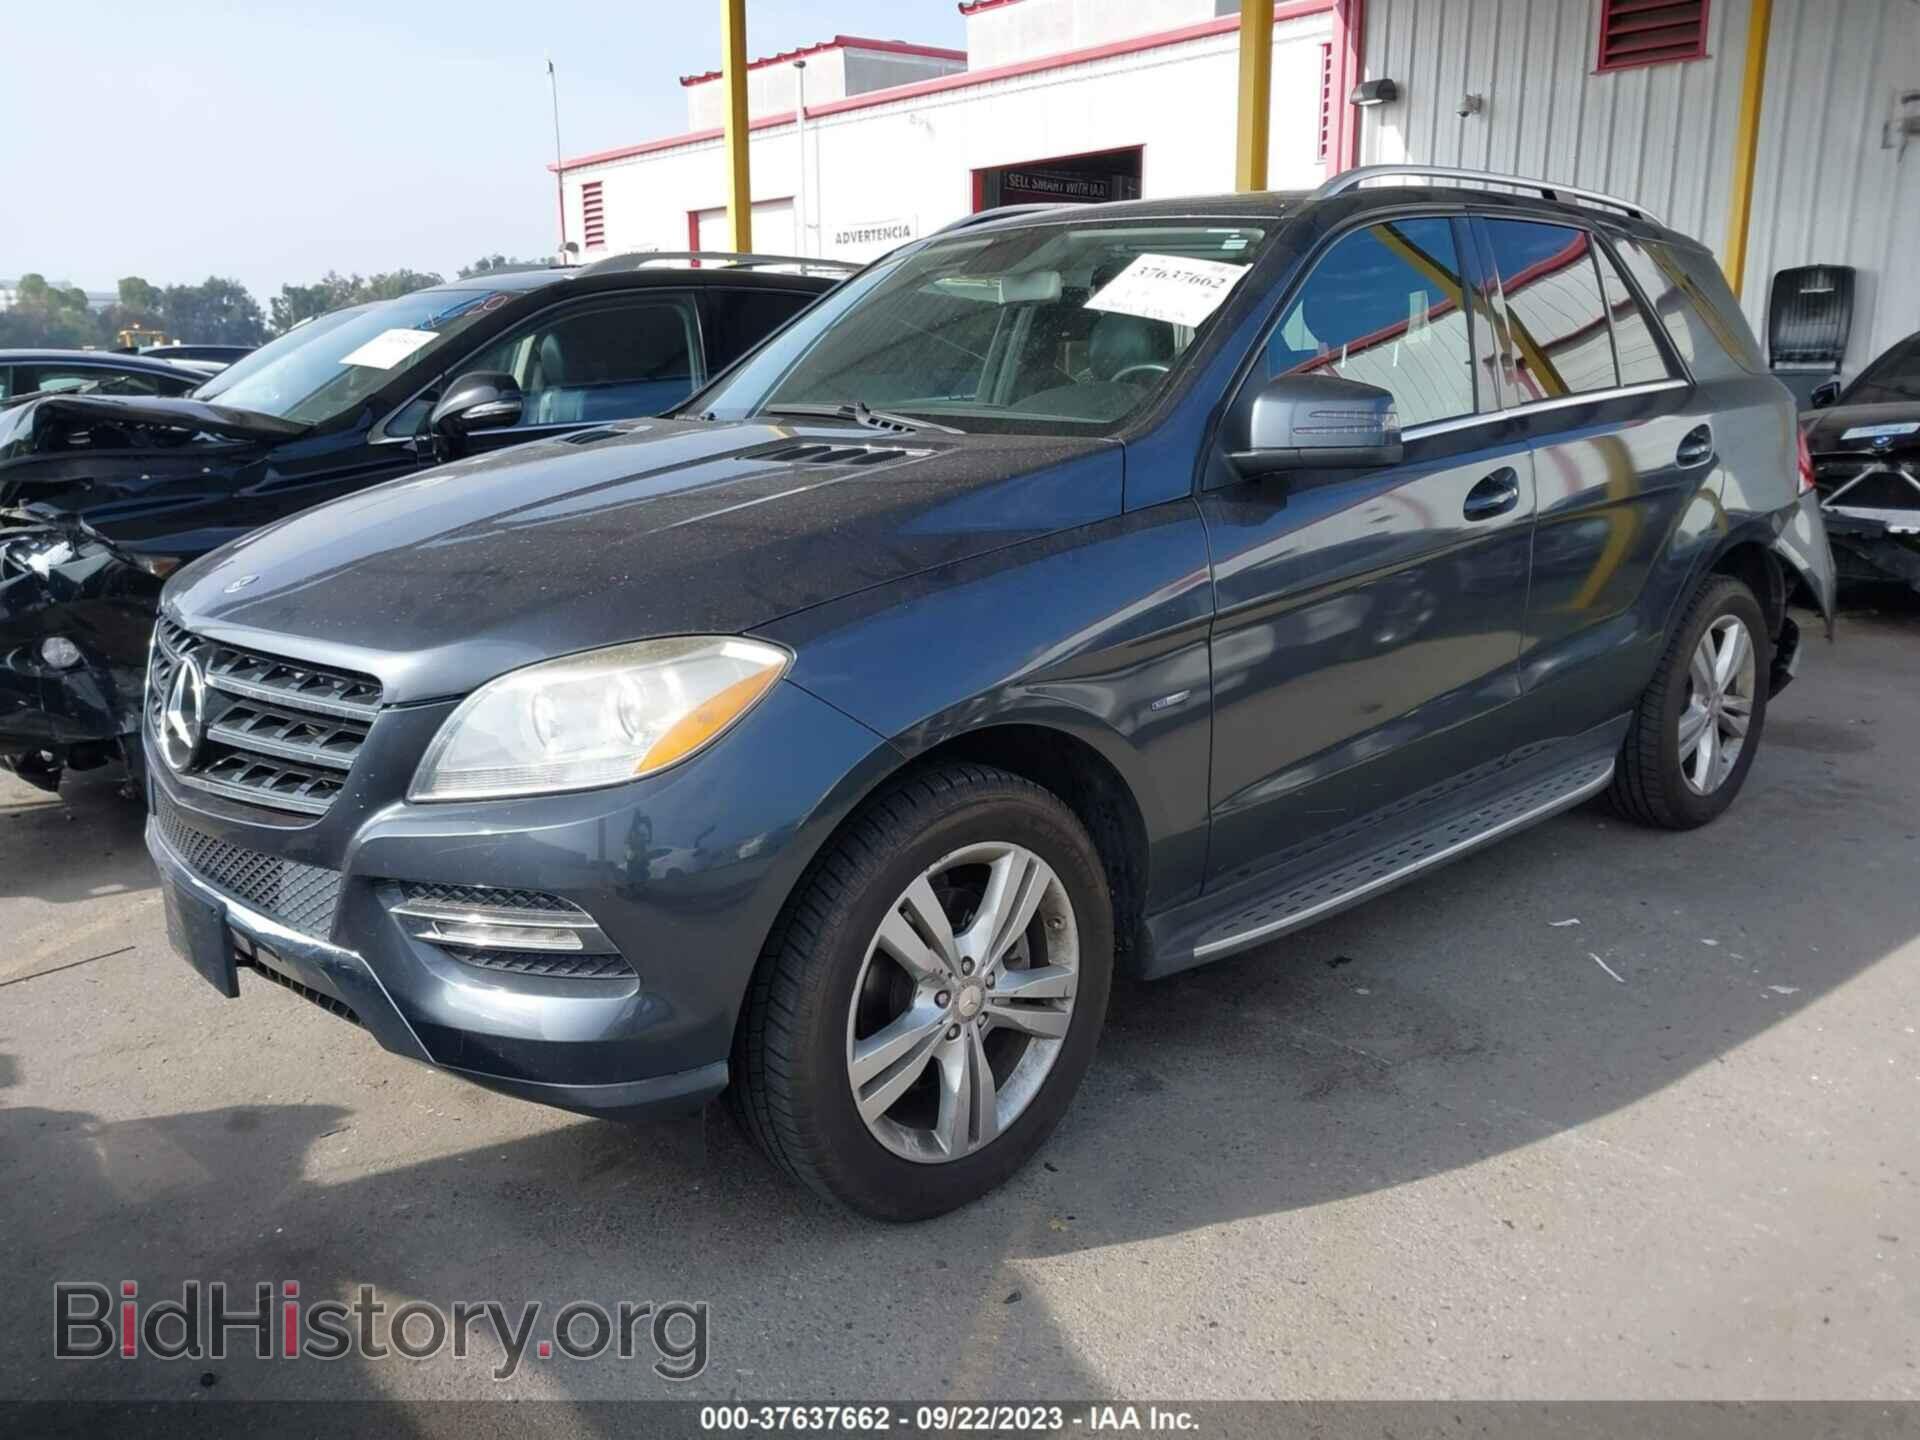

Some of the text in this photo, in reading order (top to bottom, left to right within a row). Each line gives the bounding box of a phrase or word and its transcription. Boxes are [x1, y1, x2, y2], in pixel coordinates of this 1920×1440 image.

[1008, 173, 1029, 188] SELL
[1031, 177, 1064, 192] SMART
[1066, 181, 1089, 195] WITH
[835, 225, 911, 244] ADVERTENCIA
